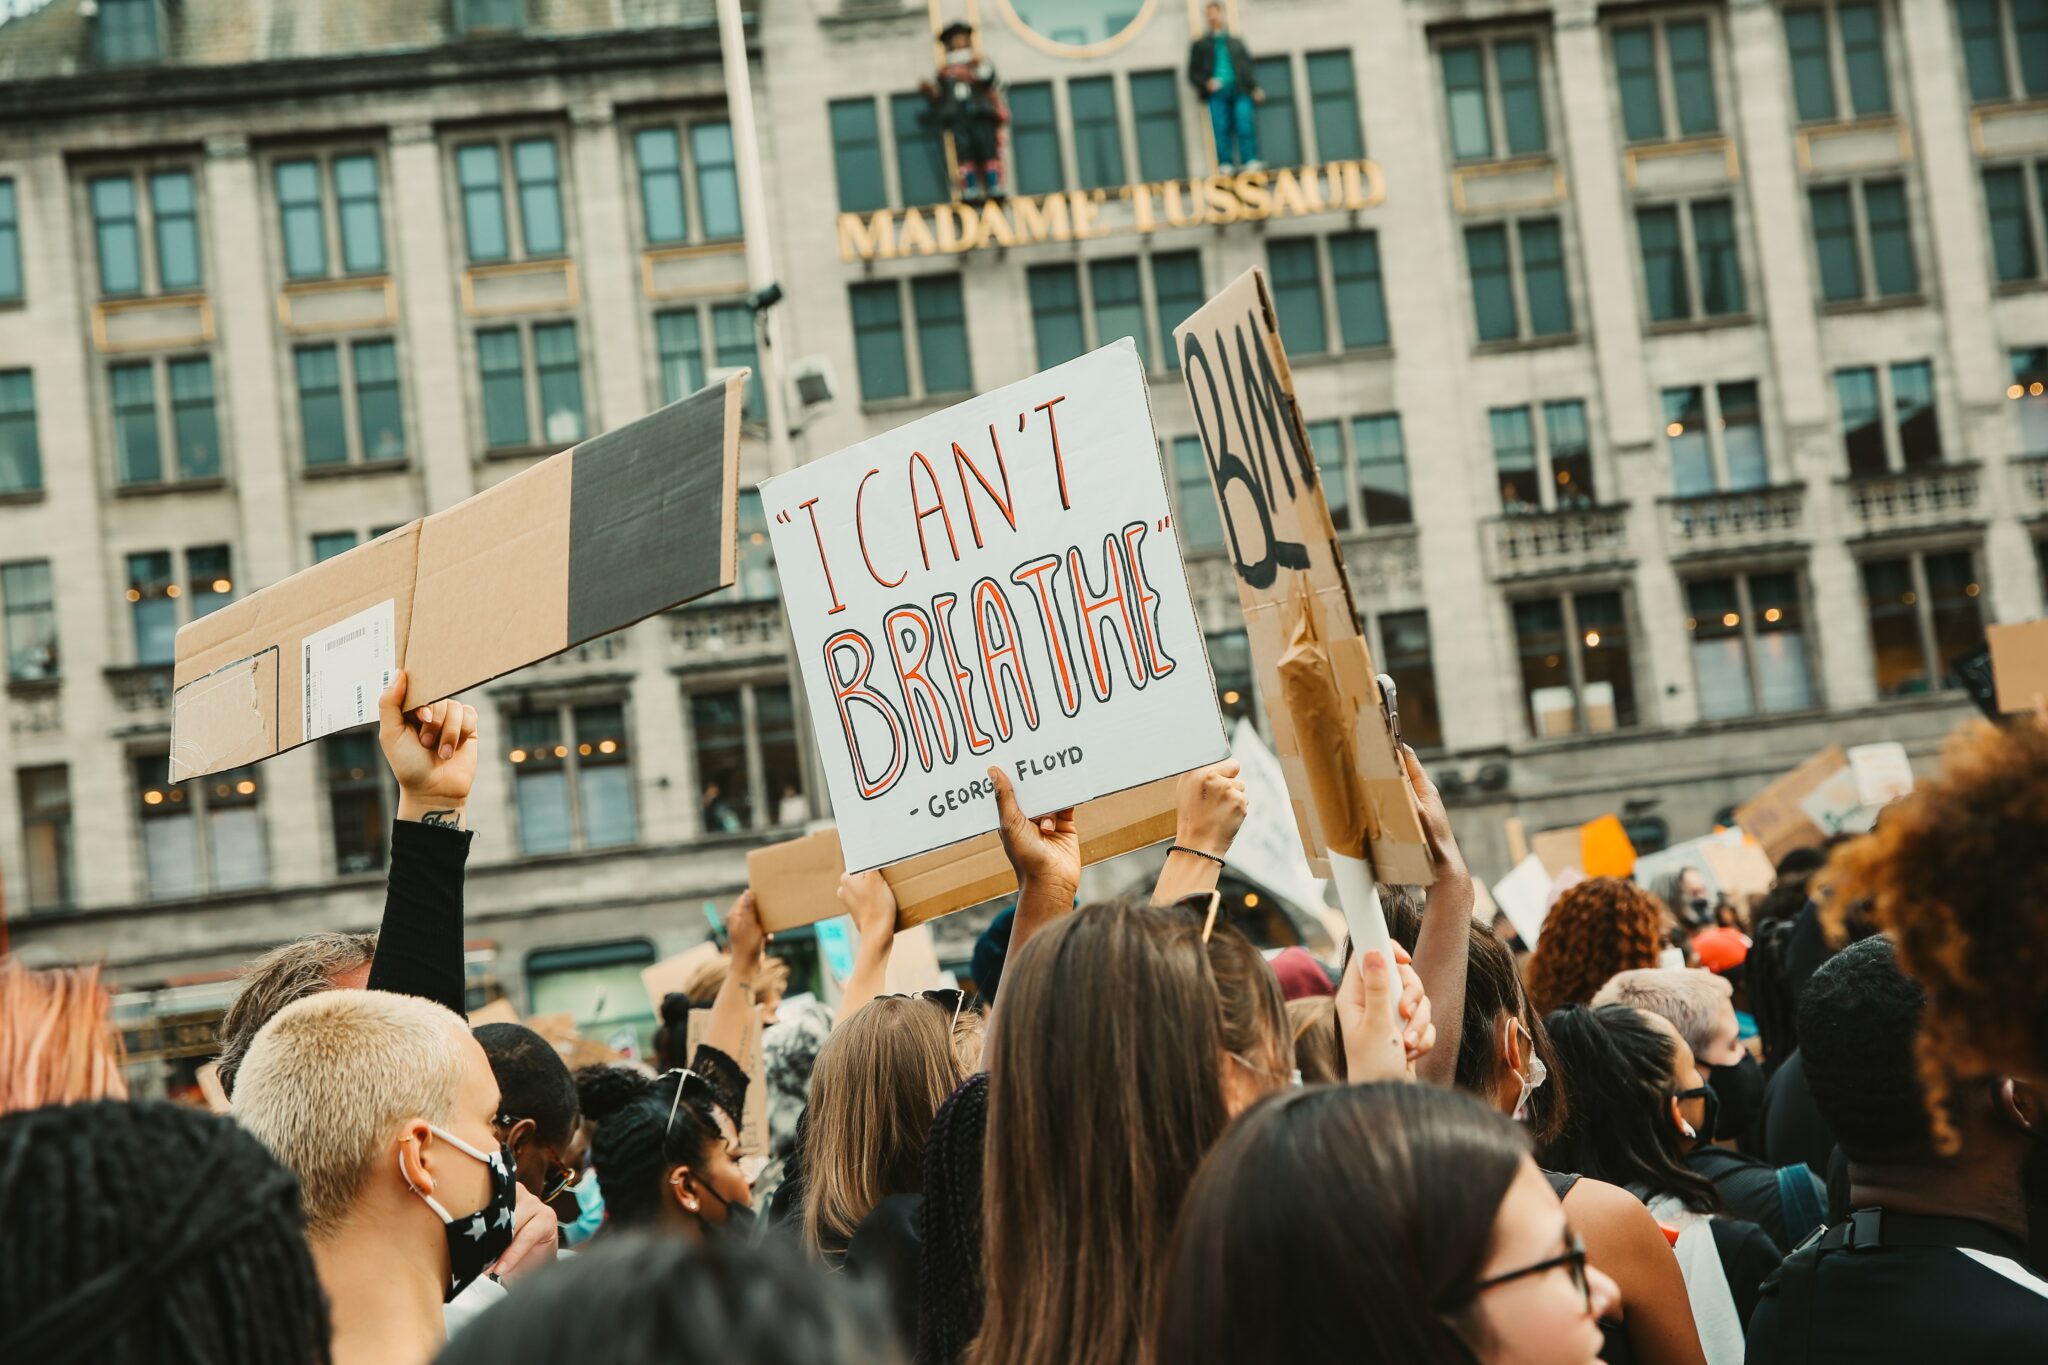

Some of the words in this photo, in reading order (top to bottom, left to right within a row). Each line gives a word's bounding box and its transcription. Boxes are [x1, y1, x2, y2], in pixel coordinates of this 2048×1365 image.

[837, 189, 1109, 261] MADAME
[1119, 160, 1387, 232] TUSSAUD
[856, 395, 1071, 589] CAN'T
[822, 515, 1176, 801] BREATHE"
[928, 777, 996, 818] GEORG
[1015, 745, 1084, 782] FLOYD
